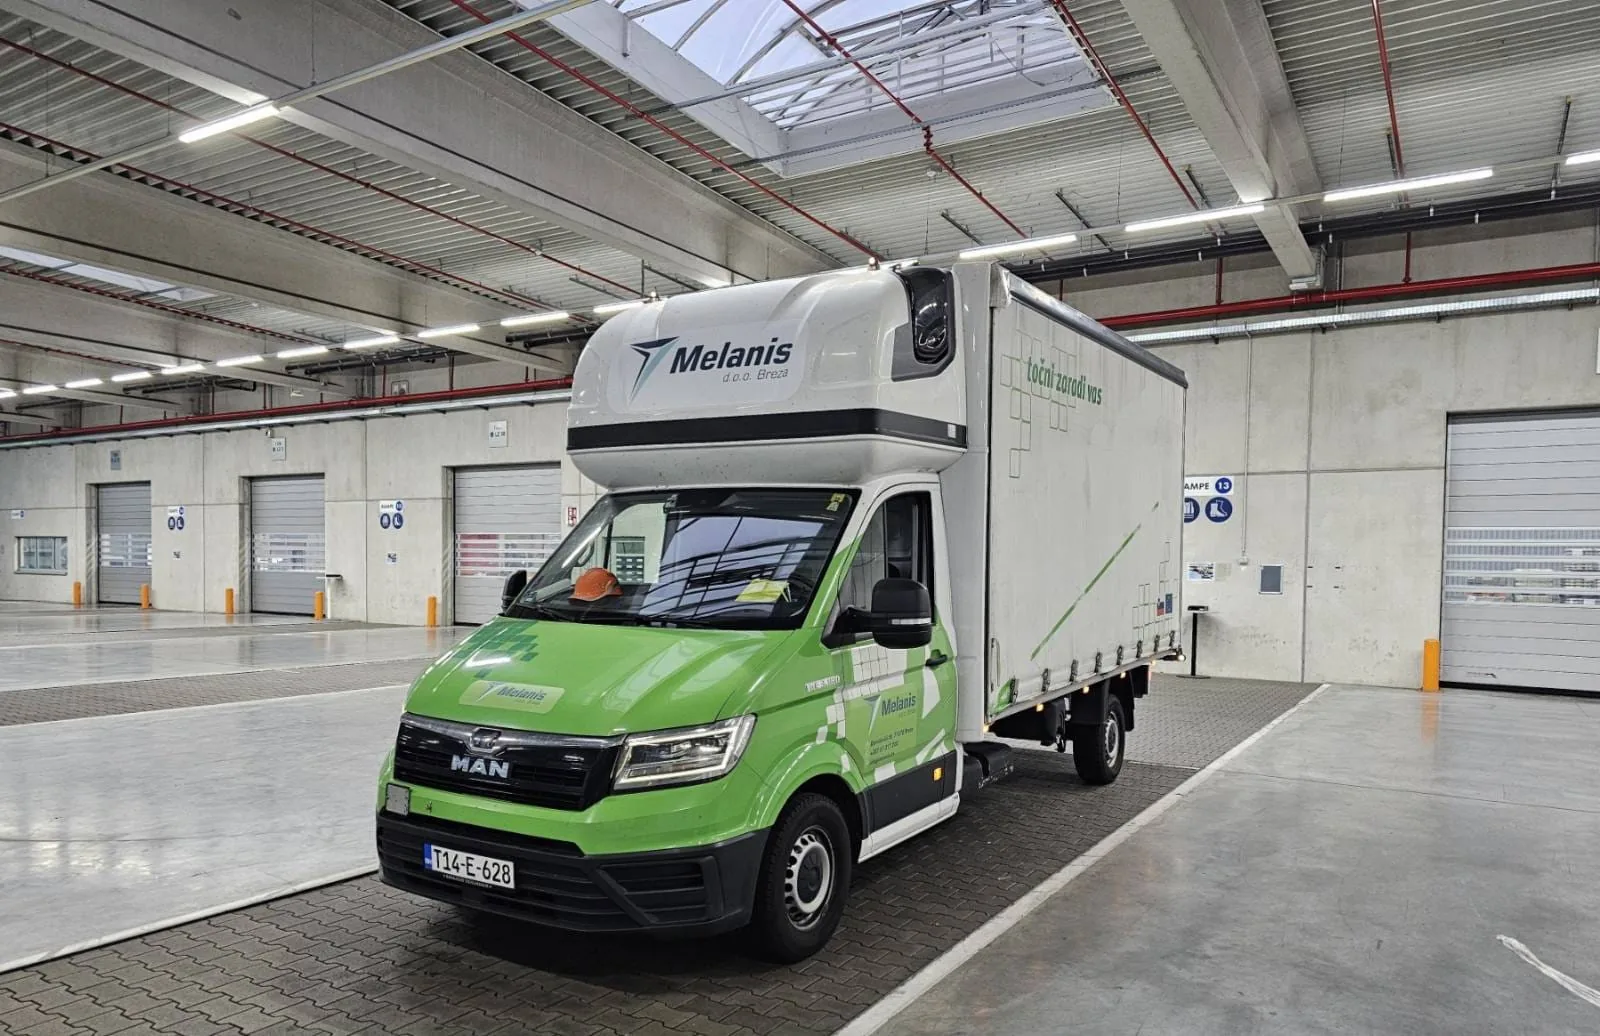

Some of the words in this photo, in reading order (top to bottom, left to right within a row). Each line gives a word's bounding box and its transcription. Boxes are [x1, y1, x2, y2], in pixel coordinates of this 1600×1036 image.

[669, 337, 793, 374] Melanis
[722, 371, 752, 383] d.o.o.
[757, 367, 789, 380] Breza
[1027, 356, 1055, 389] točni
[1056, 374, 1086, 400] zaradi
[1087, 384, 1103, 405] vas
[1184, 482, 1210, 490] AMPE
[1217, 482, 1231, 490] 13
[496, 686, 548, 701] Melanis
[881, 692, 916, 716] Melanis
[450, 754, 510, 779] MAN
[433, 848, 511, 885] T14-E-628
